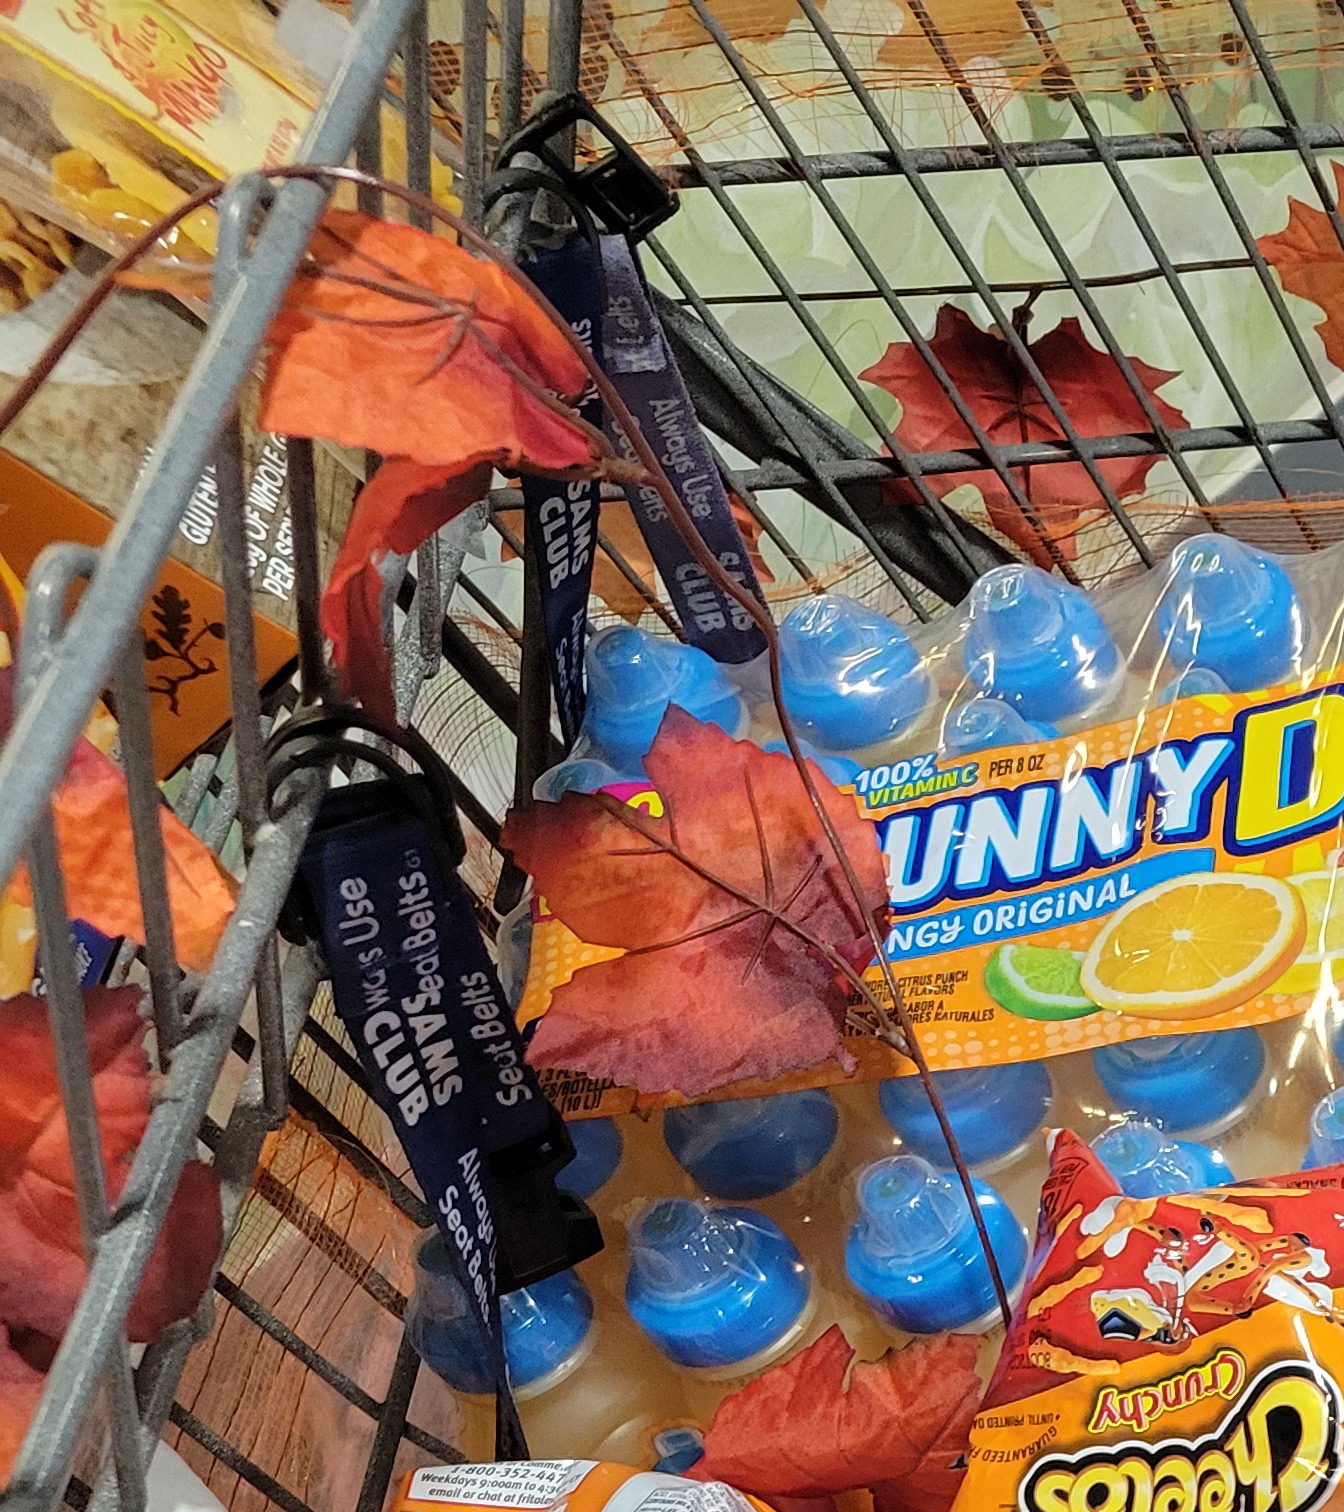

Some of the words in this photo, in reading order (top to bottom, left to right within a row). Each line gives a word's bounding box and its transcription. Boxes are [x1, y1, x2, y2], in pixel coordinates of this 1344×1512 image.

[650, 400, 695, 475] Always
[179, 473, 219, 545] GLUTEN
[540, 497, 570, 589] CLUB
[568, 479, 591, 576] SAMS
[262, 557, 296, 601] PER
[675, 562, 726, 633] CLUB
[855, 755, 937, 796] 100%
[868, 771, 957, 808] VITAMIN
[989, 759, 1013, 778] PER
[1016, 757, 1025, 775] 8
[1028, 753, 1045, 771] OZ
[338, 876, 380, 947] Use
[398, 870, 437, 951] Belts
[933, 970, 968, 986] PUNCH
[363, 1010, 429, 1126] CLUB
[401, 995, 463, 1107] SAMS
[460, 971, 507, 1040] Belts
[485, 1040, 534, 1107] Seat
[439, 1185, 476, 1260] Seat
[458, 1148, 494, 1245] Always
[1091, 1350, 1245, 1433] Crunchy
[421, 1472, 477, 1489] Weekdays
[429, 1488, 460, 1499] email
[463, 1491, 475, 1499] or
[477, 1491, 502, 1502] chat
